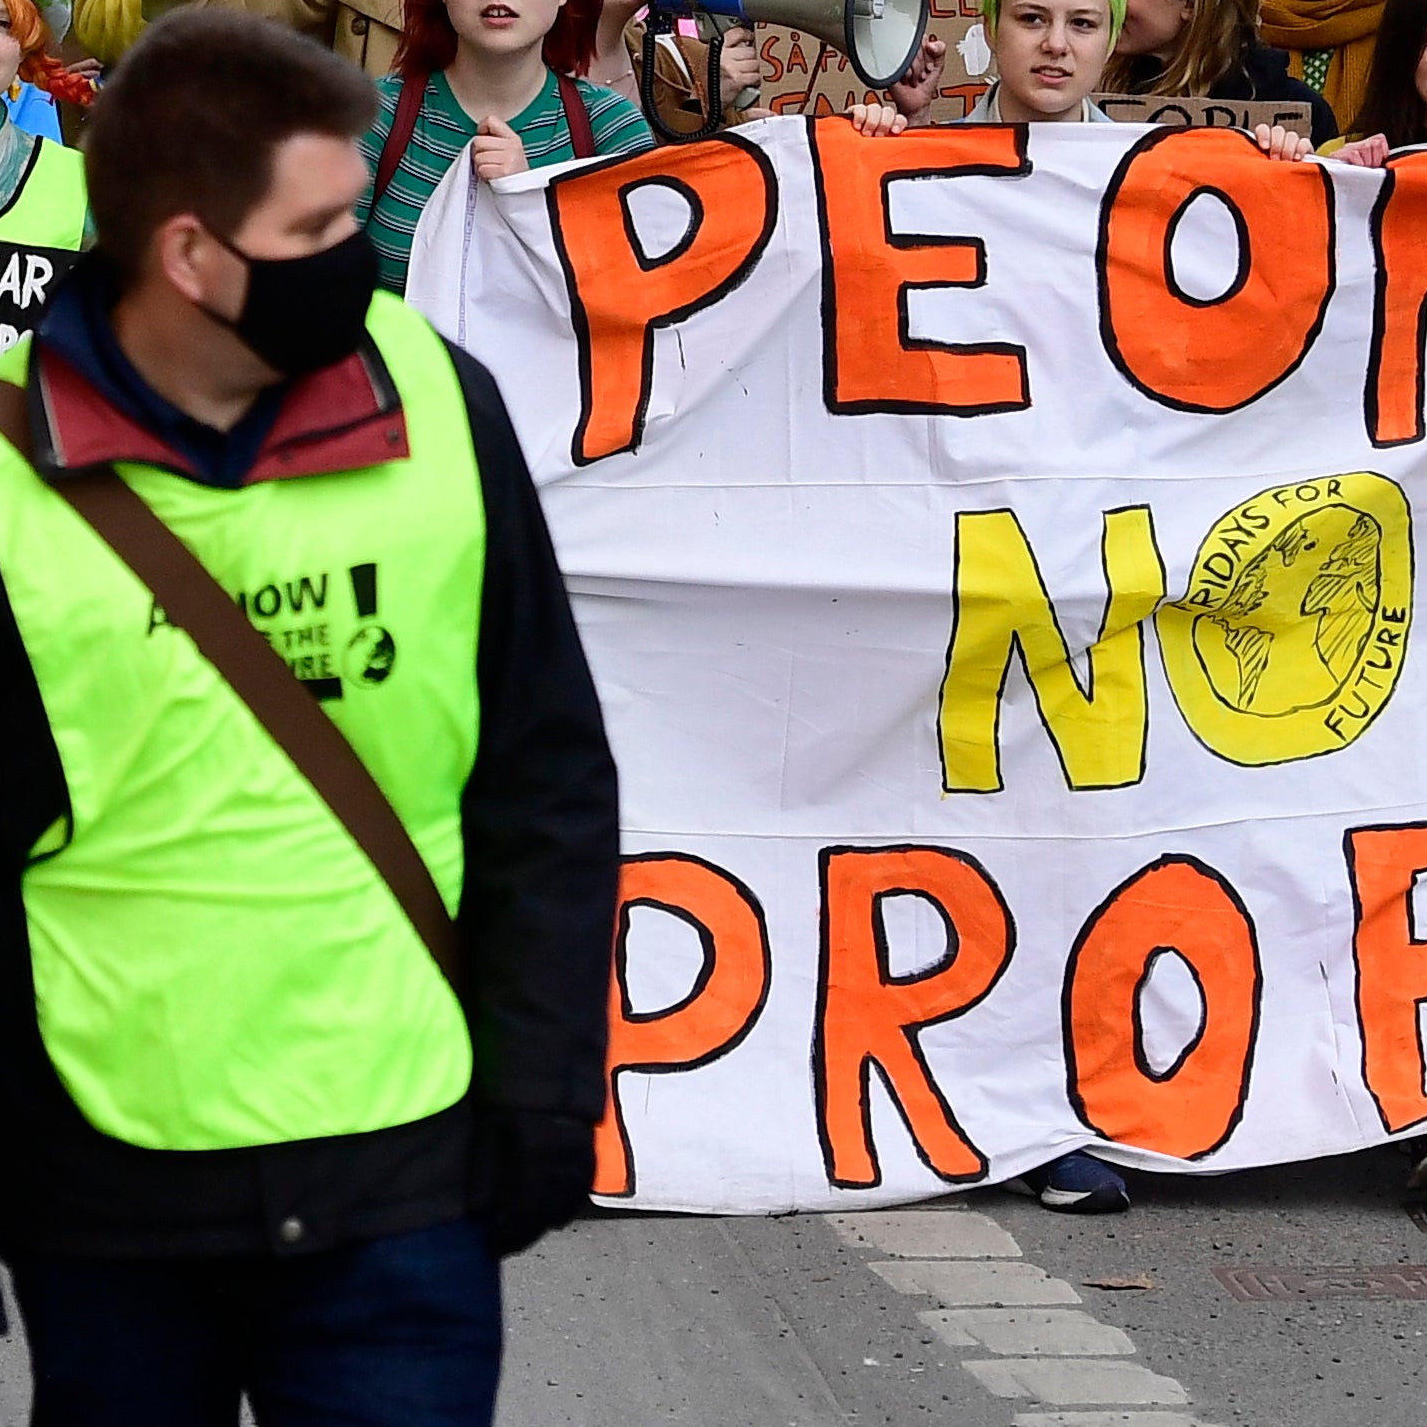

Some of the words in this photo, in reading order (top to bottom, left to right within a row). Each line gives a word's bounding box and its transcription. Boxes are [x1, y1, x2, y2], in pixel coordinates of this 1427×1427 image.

[760, 32, 809, 82] SÅ
[1186, 504, 1271, 608] RIDAYS
[1272, 479, 1344, 509] FOR
[1323, 606, 1407, 742] FUTURE
